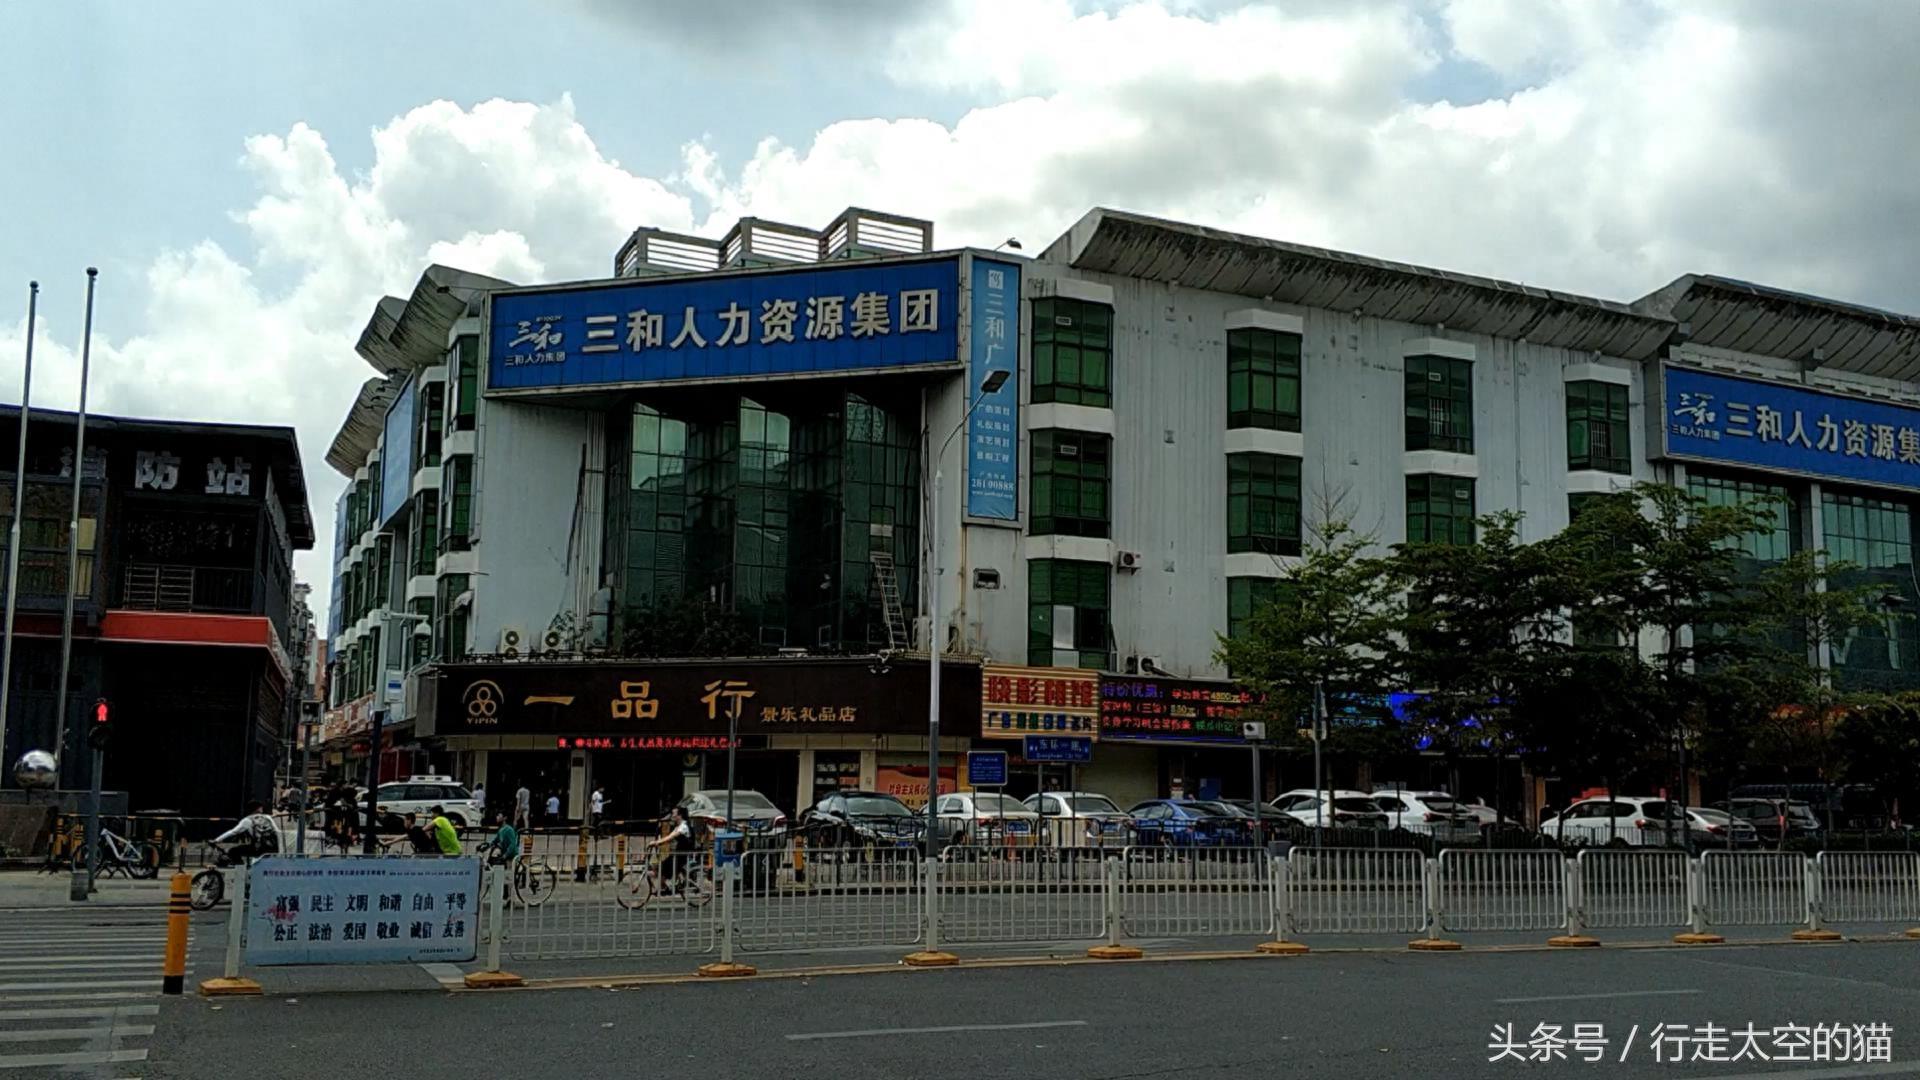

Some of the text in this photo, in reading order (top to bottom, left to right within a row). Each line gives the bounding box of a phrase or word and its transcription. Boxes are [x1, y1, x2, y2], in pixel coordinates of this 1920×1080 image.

[581, 288, 940, 354] 三和人力资源集团
[504, 351, 566, 366] 三和人力集团
[984, 292, 1006, 394] 三和广
[1725, 402, 1920, 465] 三和人力资源集
[58, 444, 252, 496] 消防站
[523, 679, 756, 720] 一品行
[759, 705, 858, 725] 景乐礼品店
[466, 717, 499, 725] YIPIN
[310, 894, 334, 912] 民主
[344, 893, 369, 912] 文明
[378, 894, 402, 912] 和谐
[412, 893, 434, 911] 自由
[444, 892, 466, 911] 平等
[273, 920, 465, 942] 公正 法治 爱国 敬业 诚信 友善
